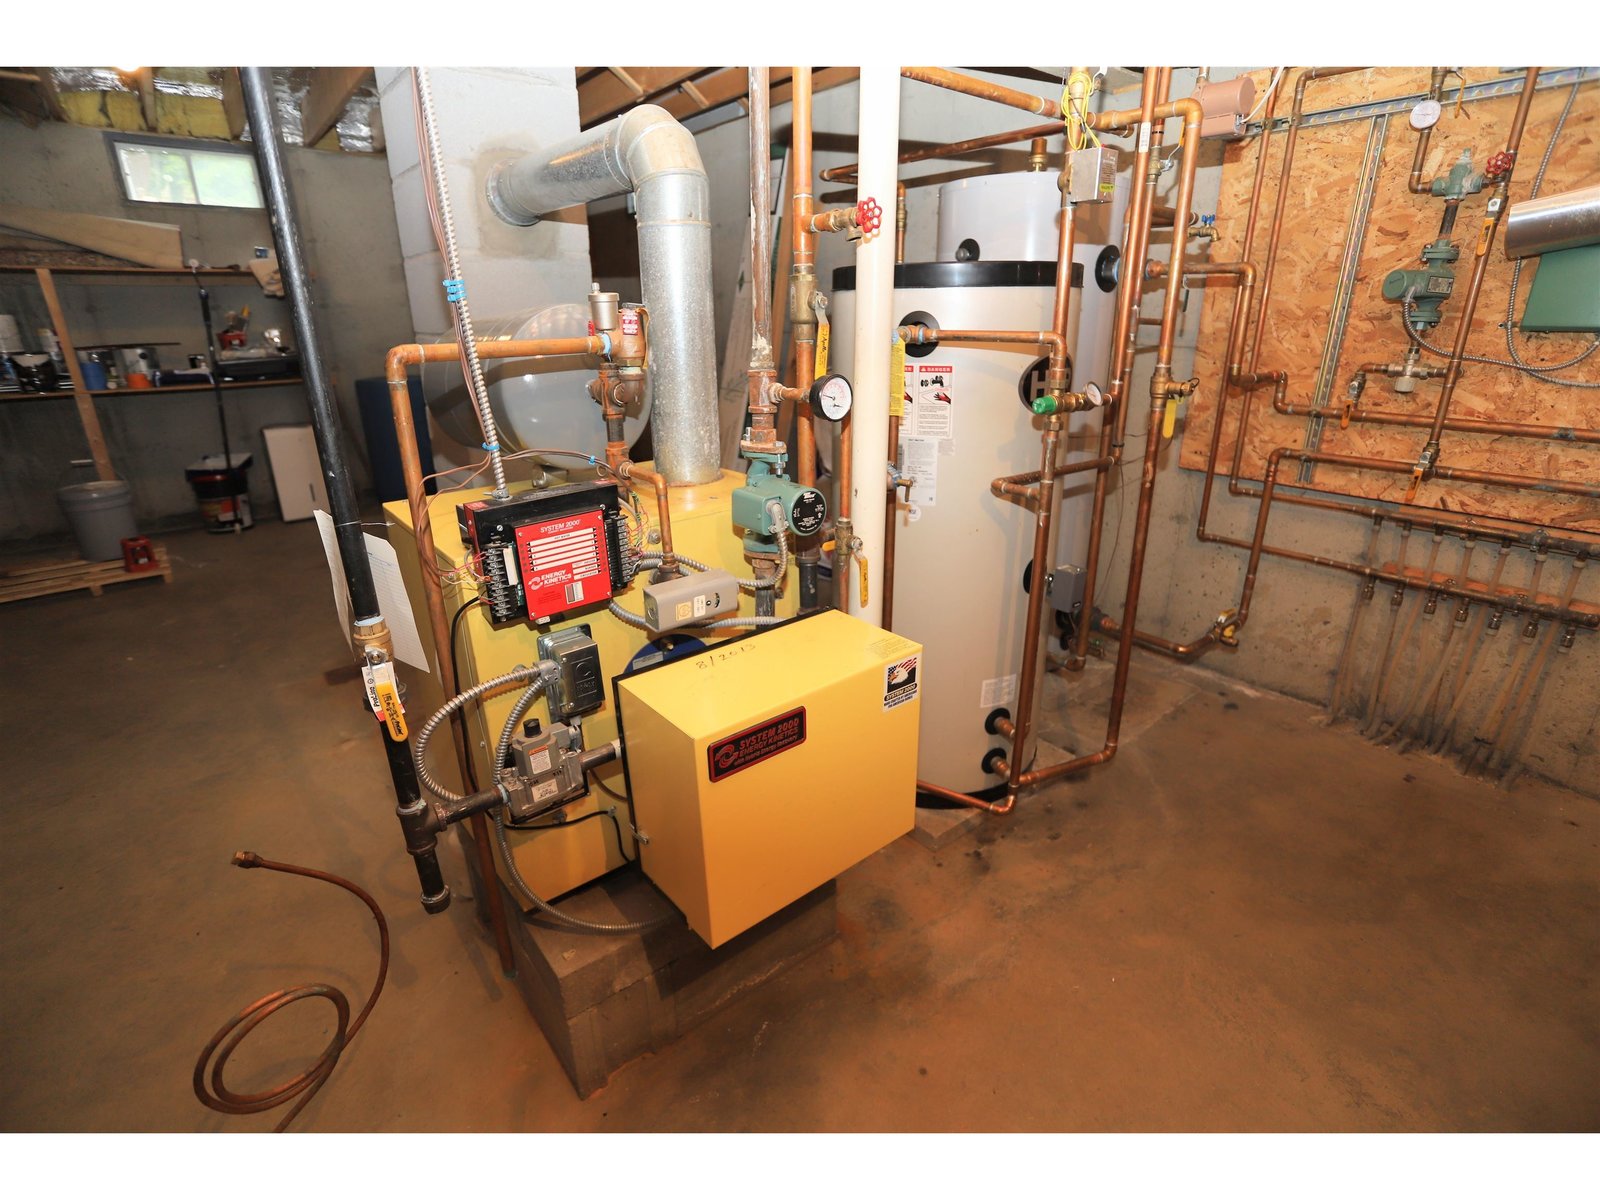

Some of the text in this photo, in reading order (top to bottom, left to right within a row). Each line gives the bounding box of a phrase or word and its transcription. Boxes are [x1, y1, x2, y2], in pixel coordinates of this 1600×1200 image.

[540, 522, 565, 533] SYSTEM
[565, 519, 580, 528] 2000
[541, 569, 567, 581] ENERGY
[543, 573, 572, 585] KINETICS
[886, 684, 916, 701] SYSTEM 2000
[739, 718, 800, 750] SYSTEM 2000
[739, 739, 768, 757] ENERGY
[768, 727, 799, 744] KINETICS
